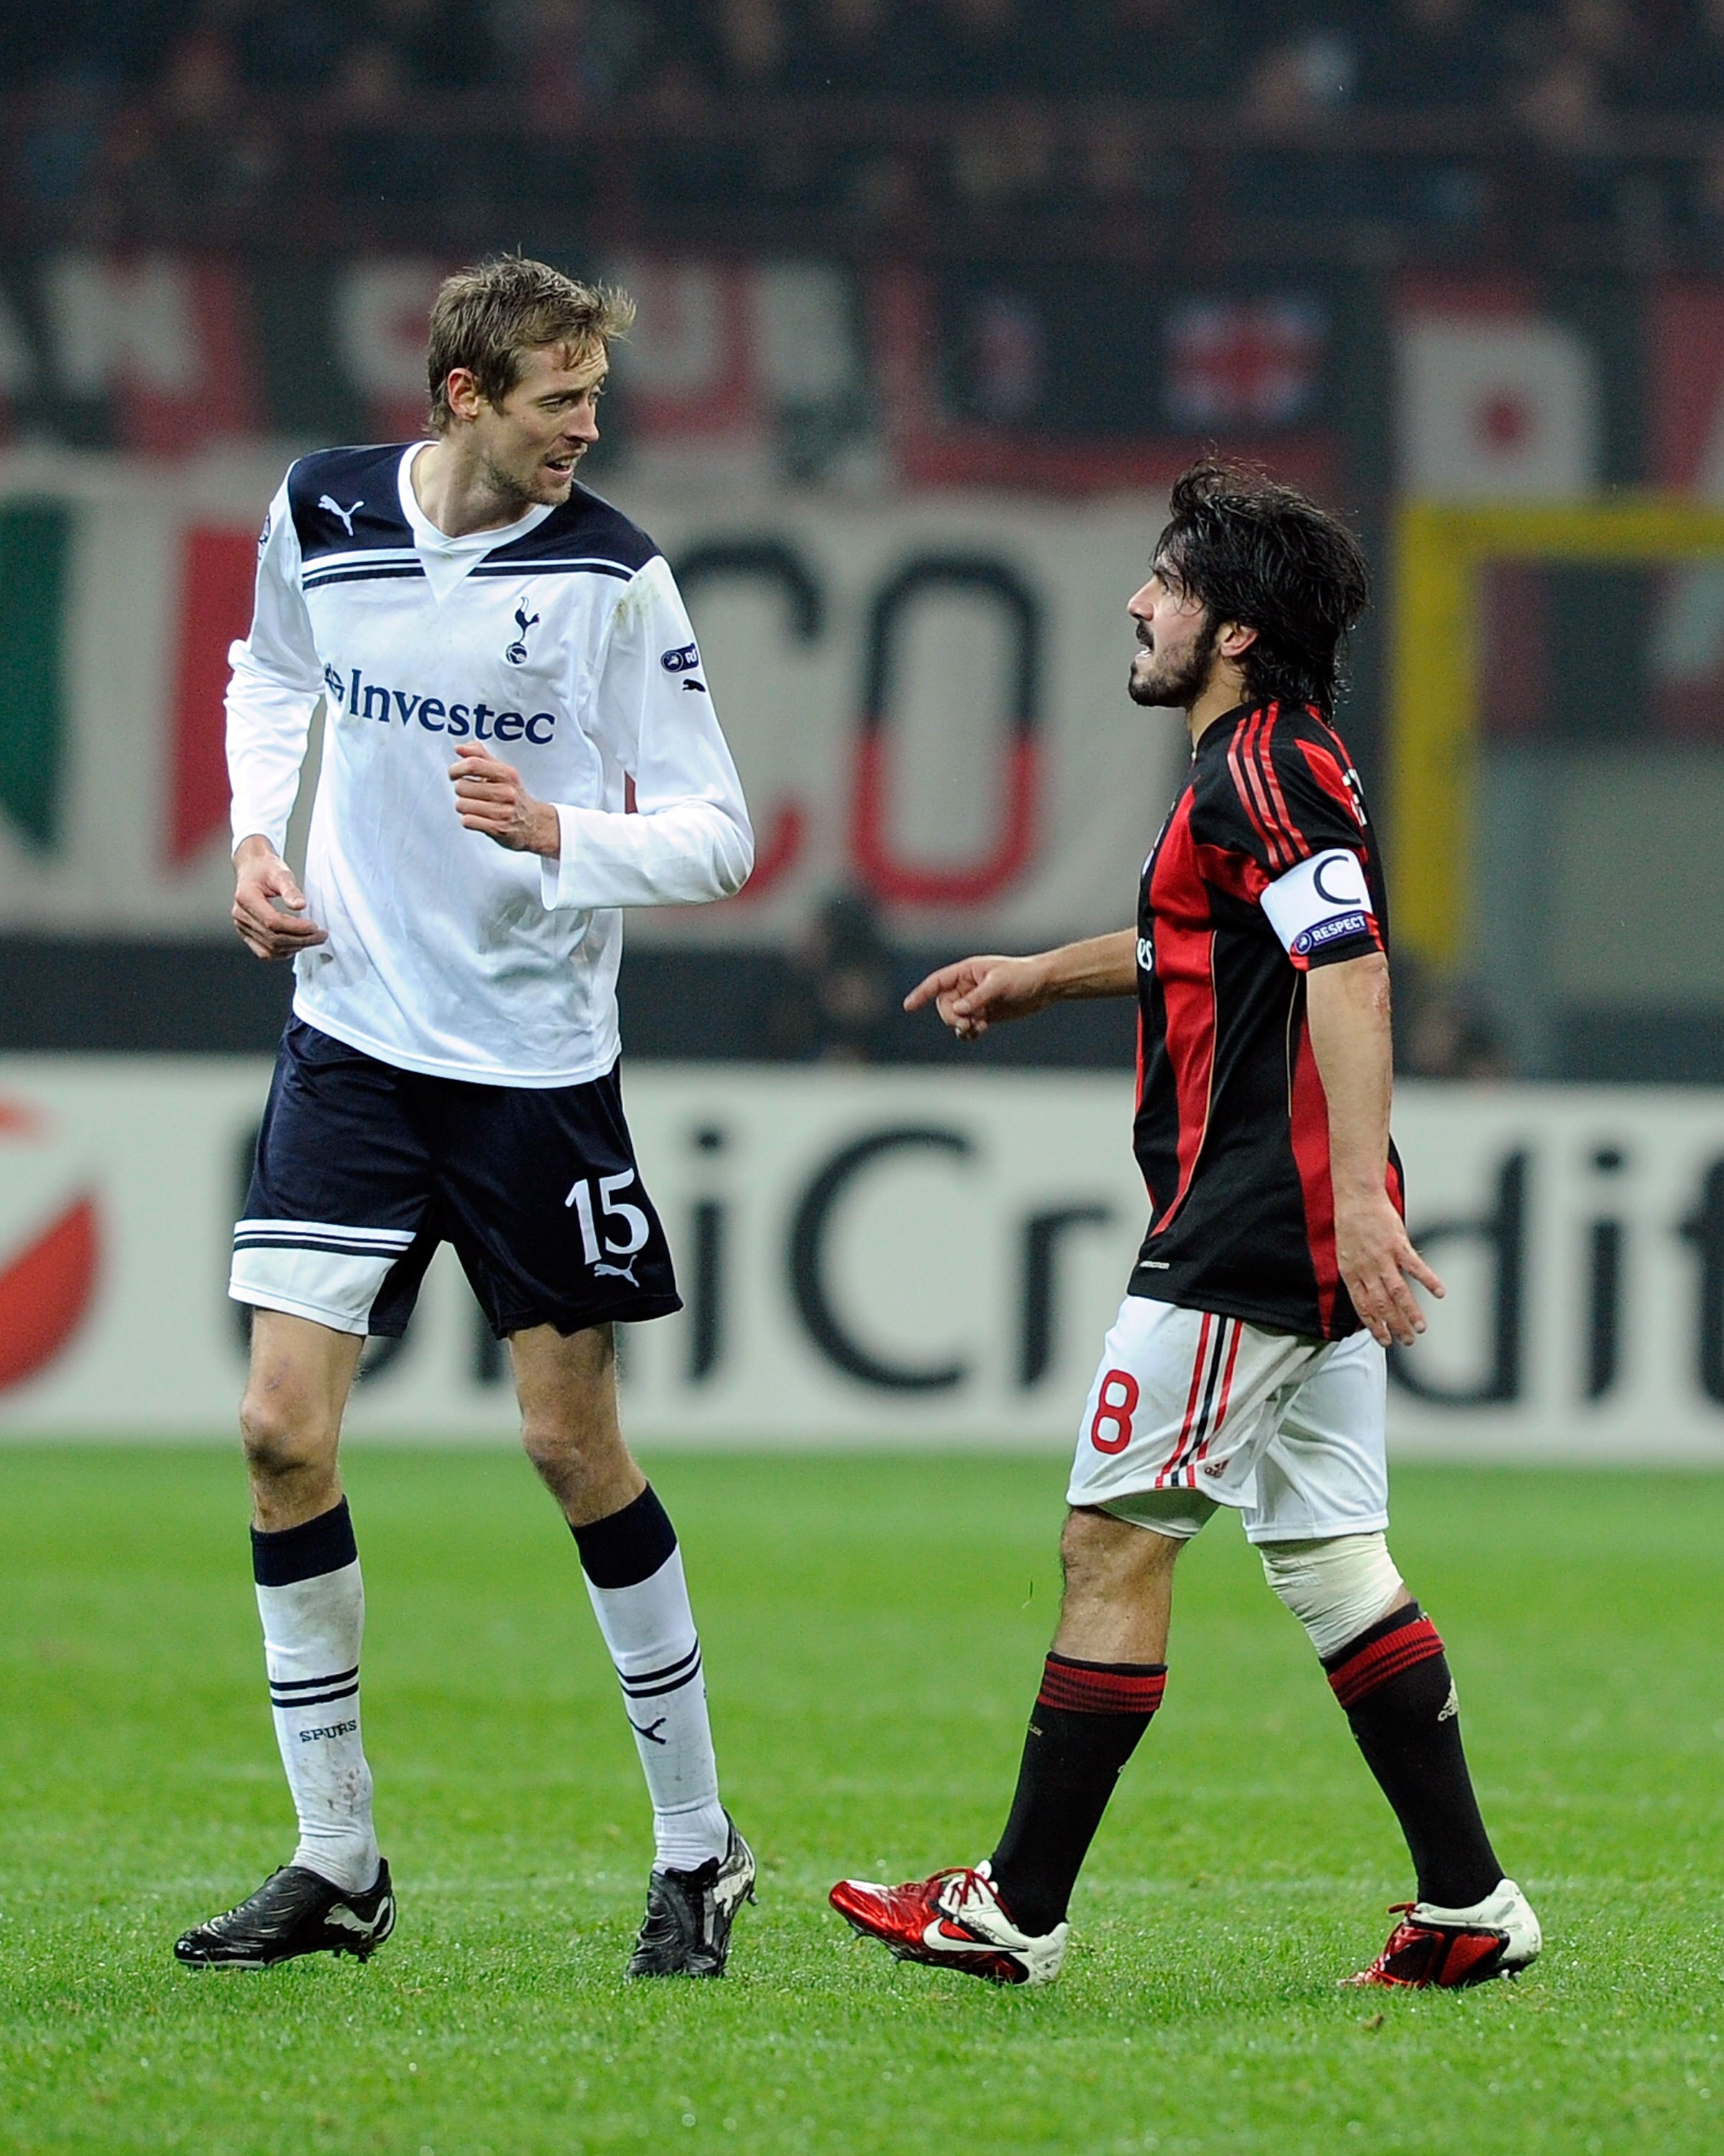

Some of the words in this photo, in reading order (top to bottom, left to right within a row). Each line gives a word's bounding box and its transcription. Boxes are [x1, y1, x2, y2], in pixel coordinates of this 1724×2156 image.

[349, 668, 556, 745] Investec
[1313, 854, 1362, 905] C
[1312, 915, 1365, 942] RESPECT
[564, 1167, 650, 1265] 15
[230, 1121, 1724, 1410] iCrdit
[1091, 1369, 1139, 1455] 8
[299, 1720, 357, 1742] SPURS
